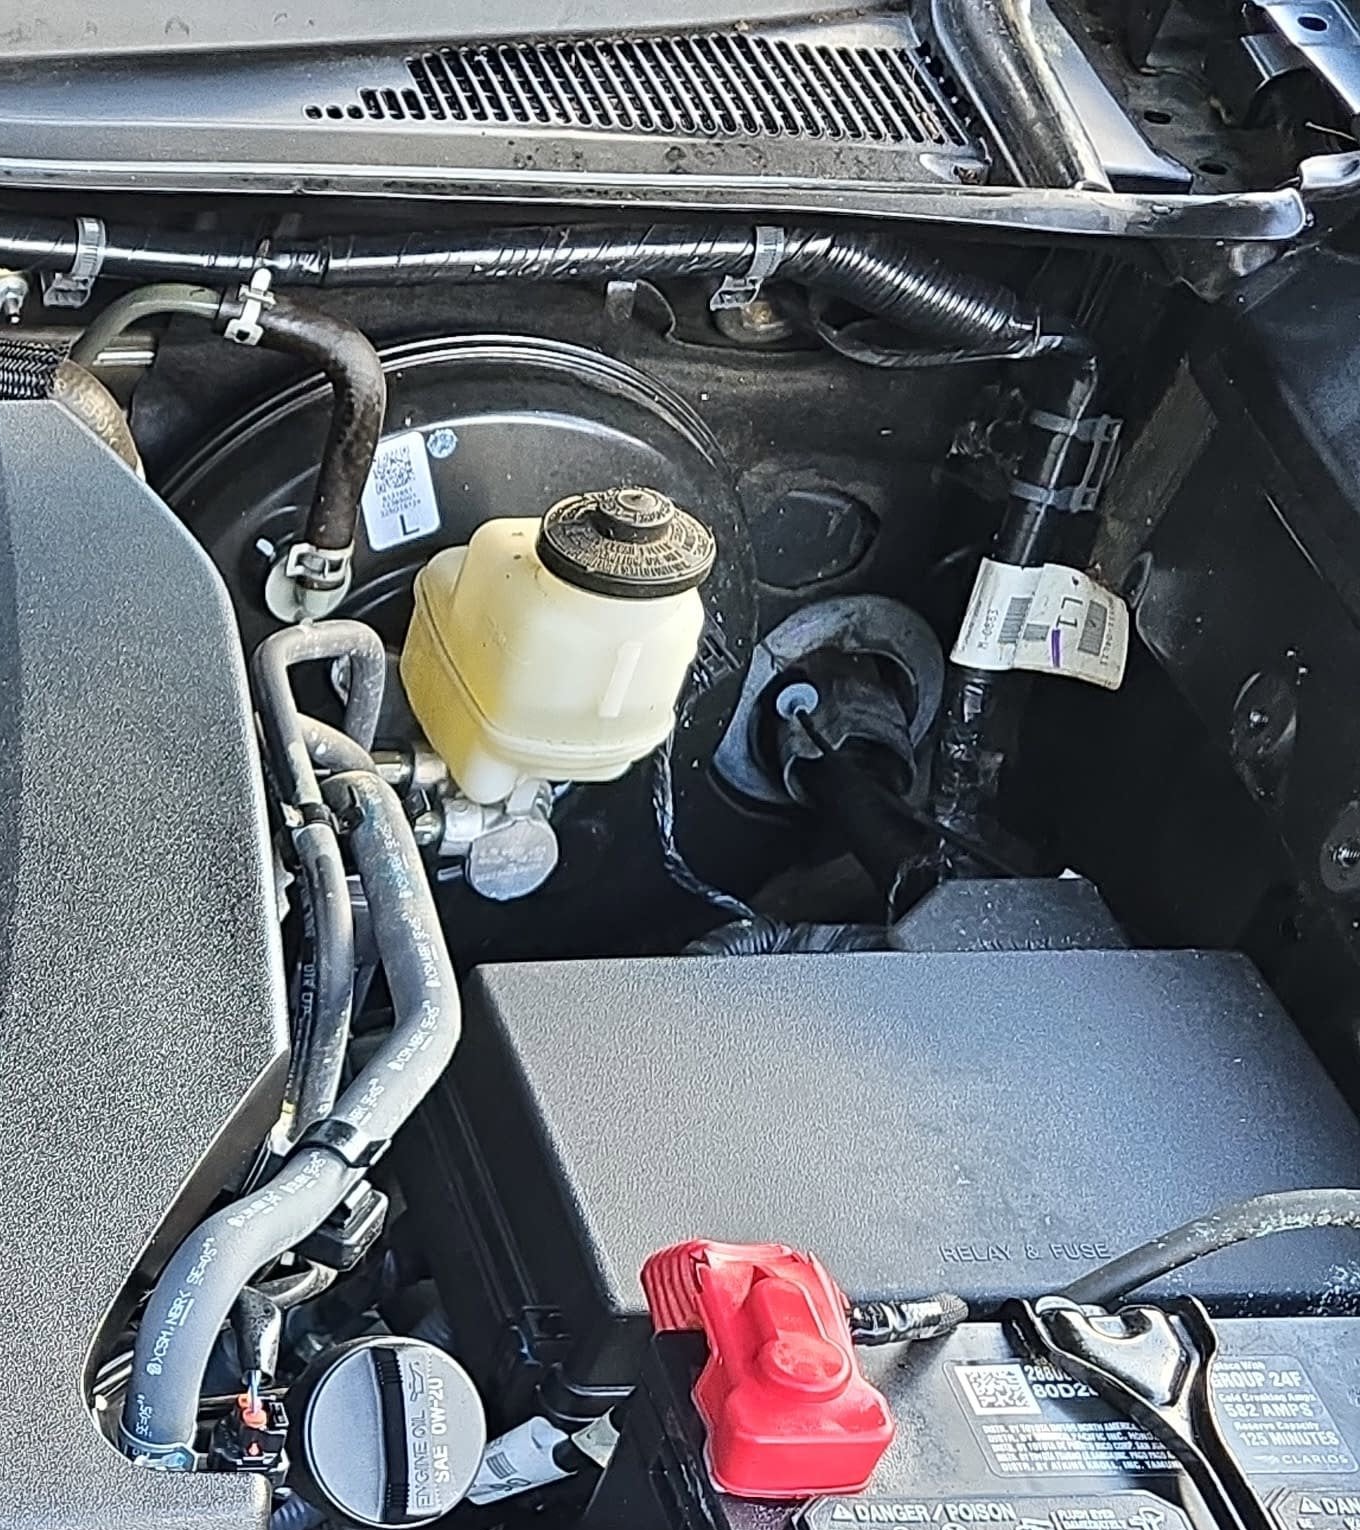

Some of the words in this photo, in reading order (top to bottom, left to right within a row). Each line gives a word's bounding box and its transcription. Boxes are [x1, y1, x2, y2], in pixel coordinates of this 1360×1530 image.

[399, 514, 420, 536] L
[938, 1243, 1011, 1262] RELAY
[1024, 1243, 1041, 1261] &
[1048, 1242, 1112, 1261] FUSE
[1268, 1371, 1302, 1388] 24F
[428, 1375, 448, 1436] 0W-20
[1223, 1403, 1260, 1418] 582
[1262, 1402, 1314, 1418] AMPS
[411, 1409, 427, 1438] OIL
[1239, 1431, 1270, 1447] 125
[1269, 1431, 1340, 1447] MINUTES
[432, 1444, 451, 1484] SAE
[1281, 1454, 1349, 1465] CLARIOS
[412, 1441, 434, 1509] ENGINE
